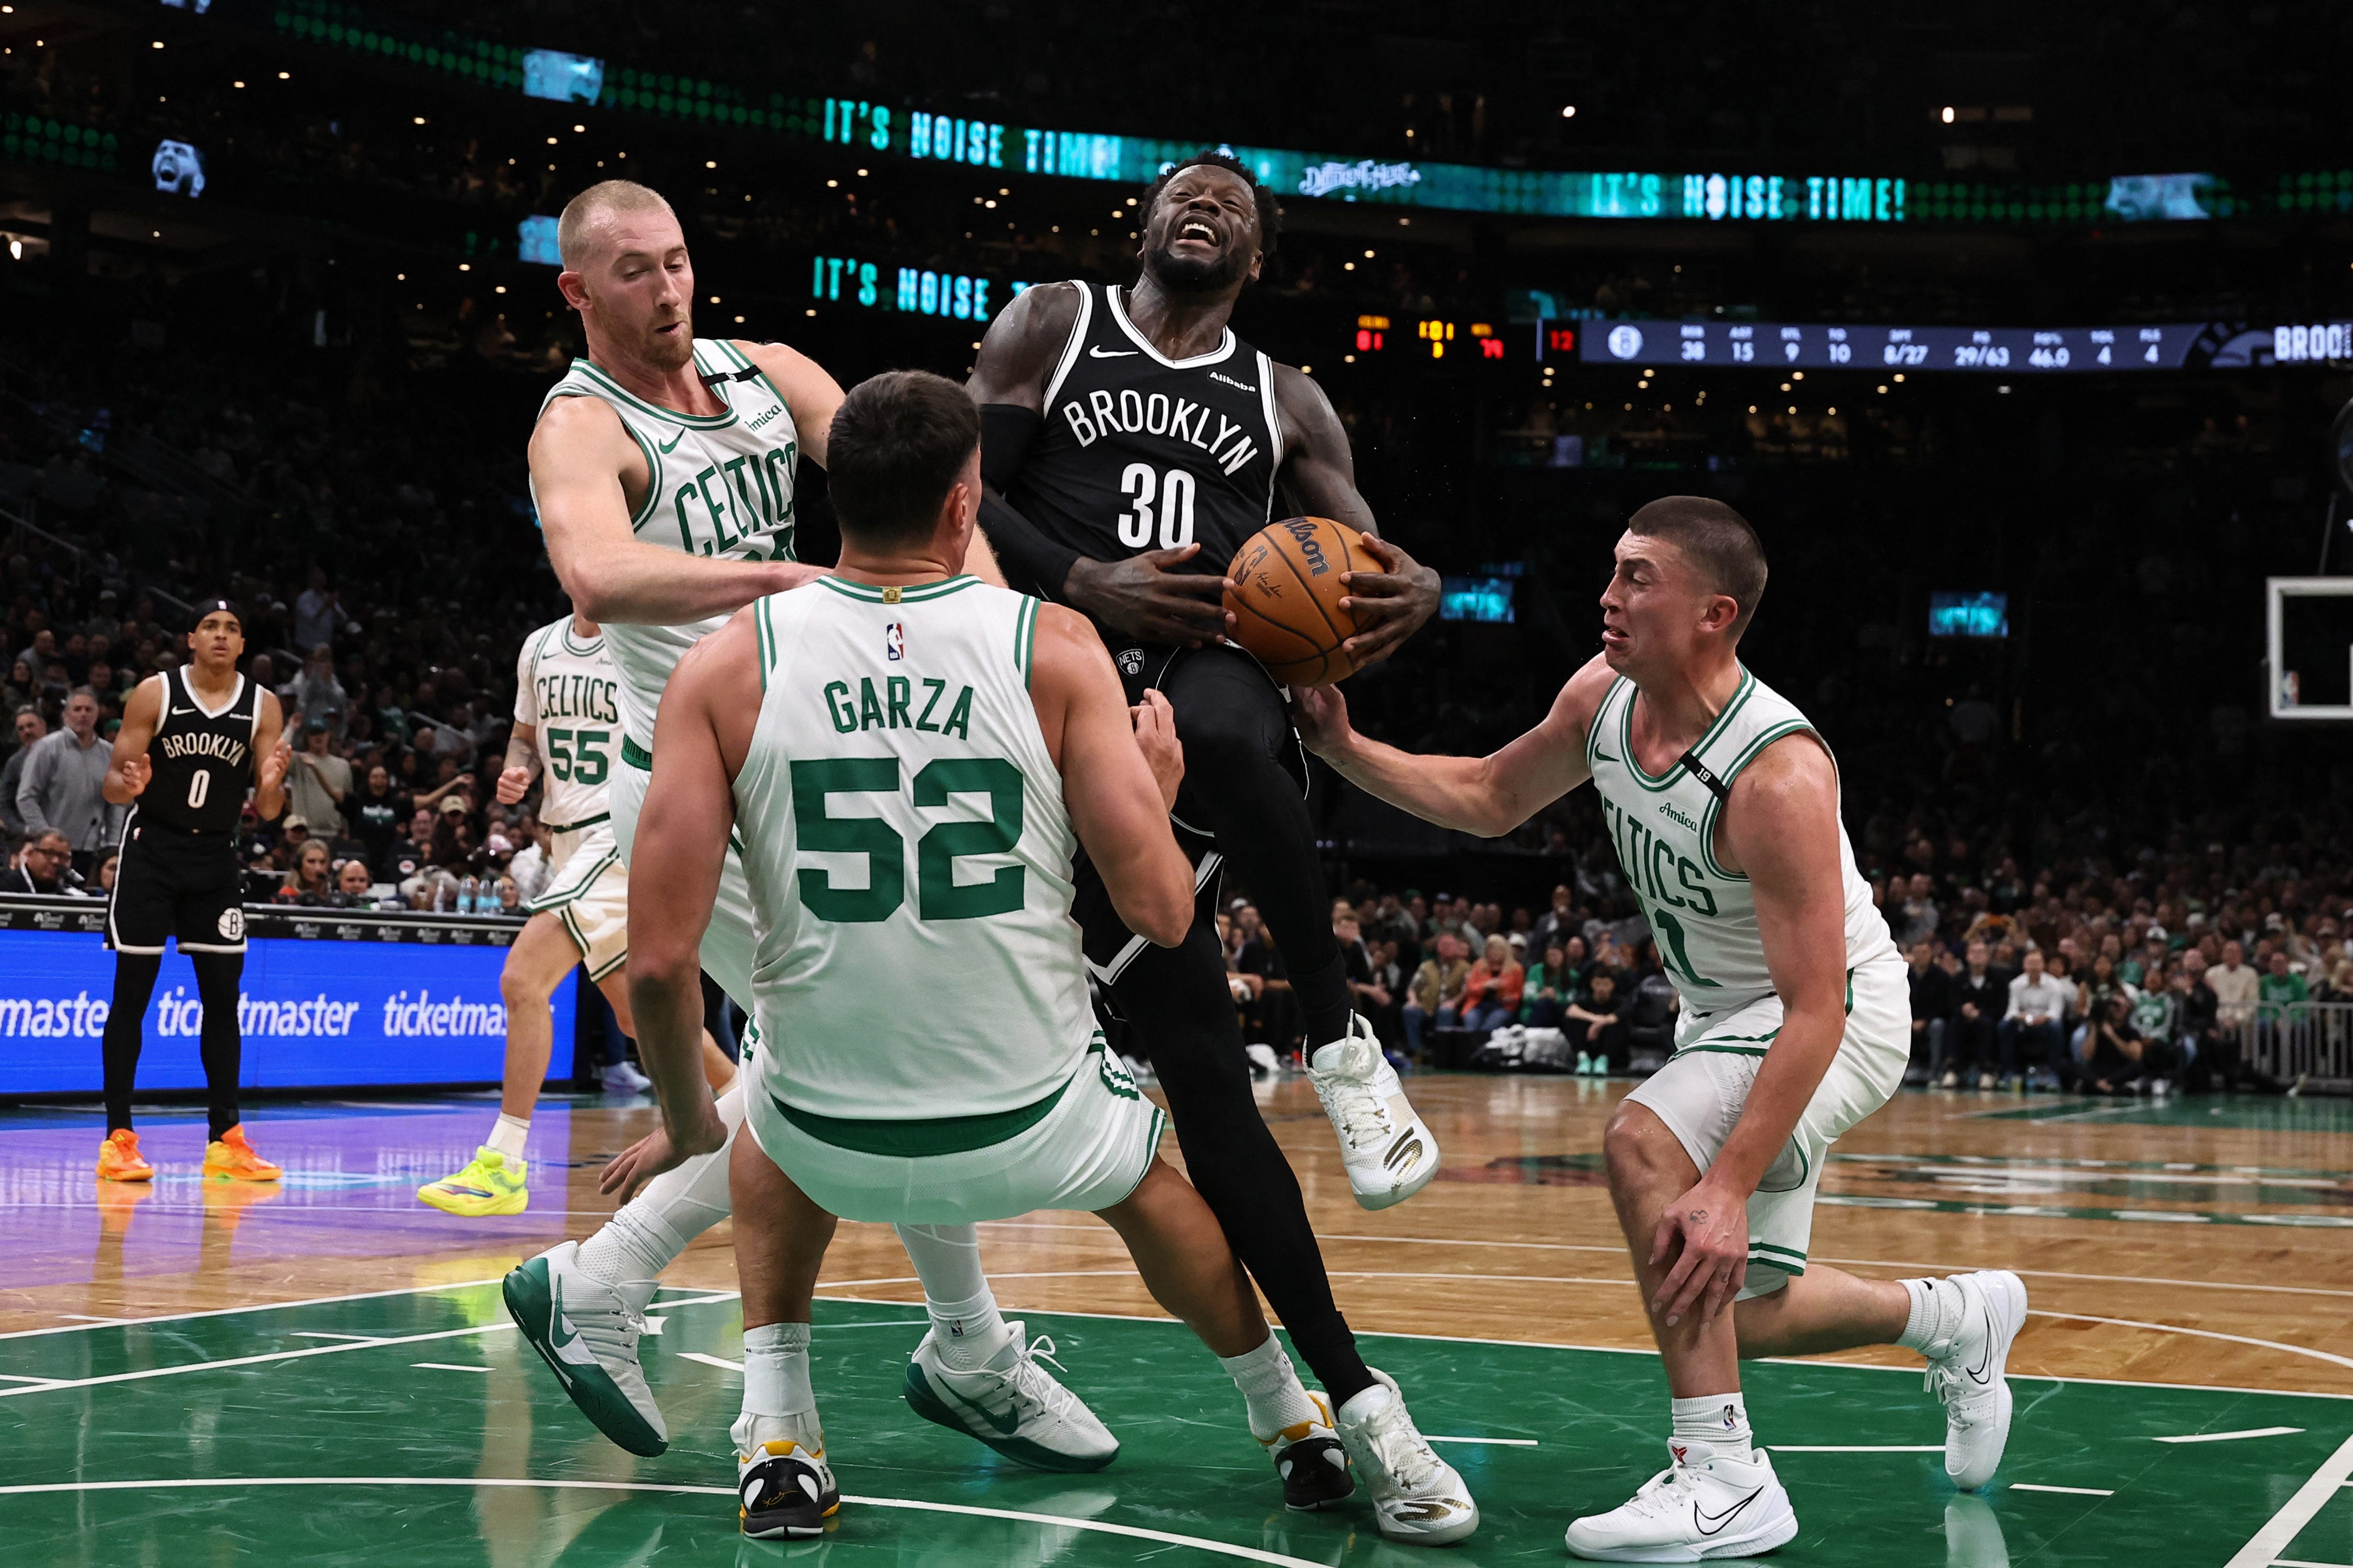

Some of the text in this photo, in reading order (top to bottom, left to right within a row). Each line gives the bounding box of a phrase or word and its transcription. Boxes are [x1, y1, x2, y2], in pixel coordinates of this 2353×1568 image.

[824, 97, 1122, 181] IT'S NOISE TIME!
[1590, 172, 1905, 222] IT'S NOISE TIME!
[814, 256, 878, 307] IT'S
[1733, 341, 1754, 362] 15
[1829, 343, 1851, 363] 10
[1209, 370, 1256, 393] Alibaba
[1063, 389, 1258, 477] BROOKLYN
[1118, 463, 1195, 551] 30
[1119, 651, 1142, 666] NETS
[536, 674, 619, 724] CELTICS
[824, 675, 973, 740] GARZA
[162, 732, 246, 767] BROOKLYN
[547, 727, 610, 785] 55
[187, 769, 211, 809] 0
[1696, 767, 1711, 783] 19
[789, 756, 1026, 922] 52
[1660, 802, 1698, 832] Amica
[0, 985, 508, 1038] maste tictmaster ticketma
